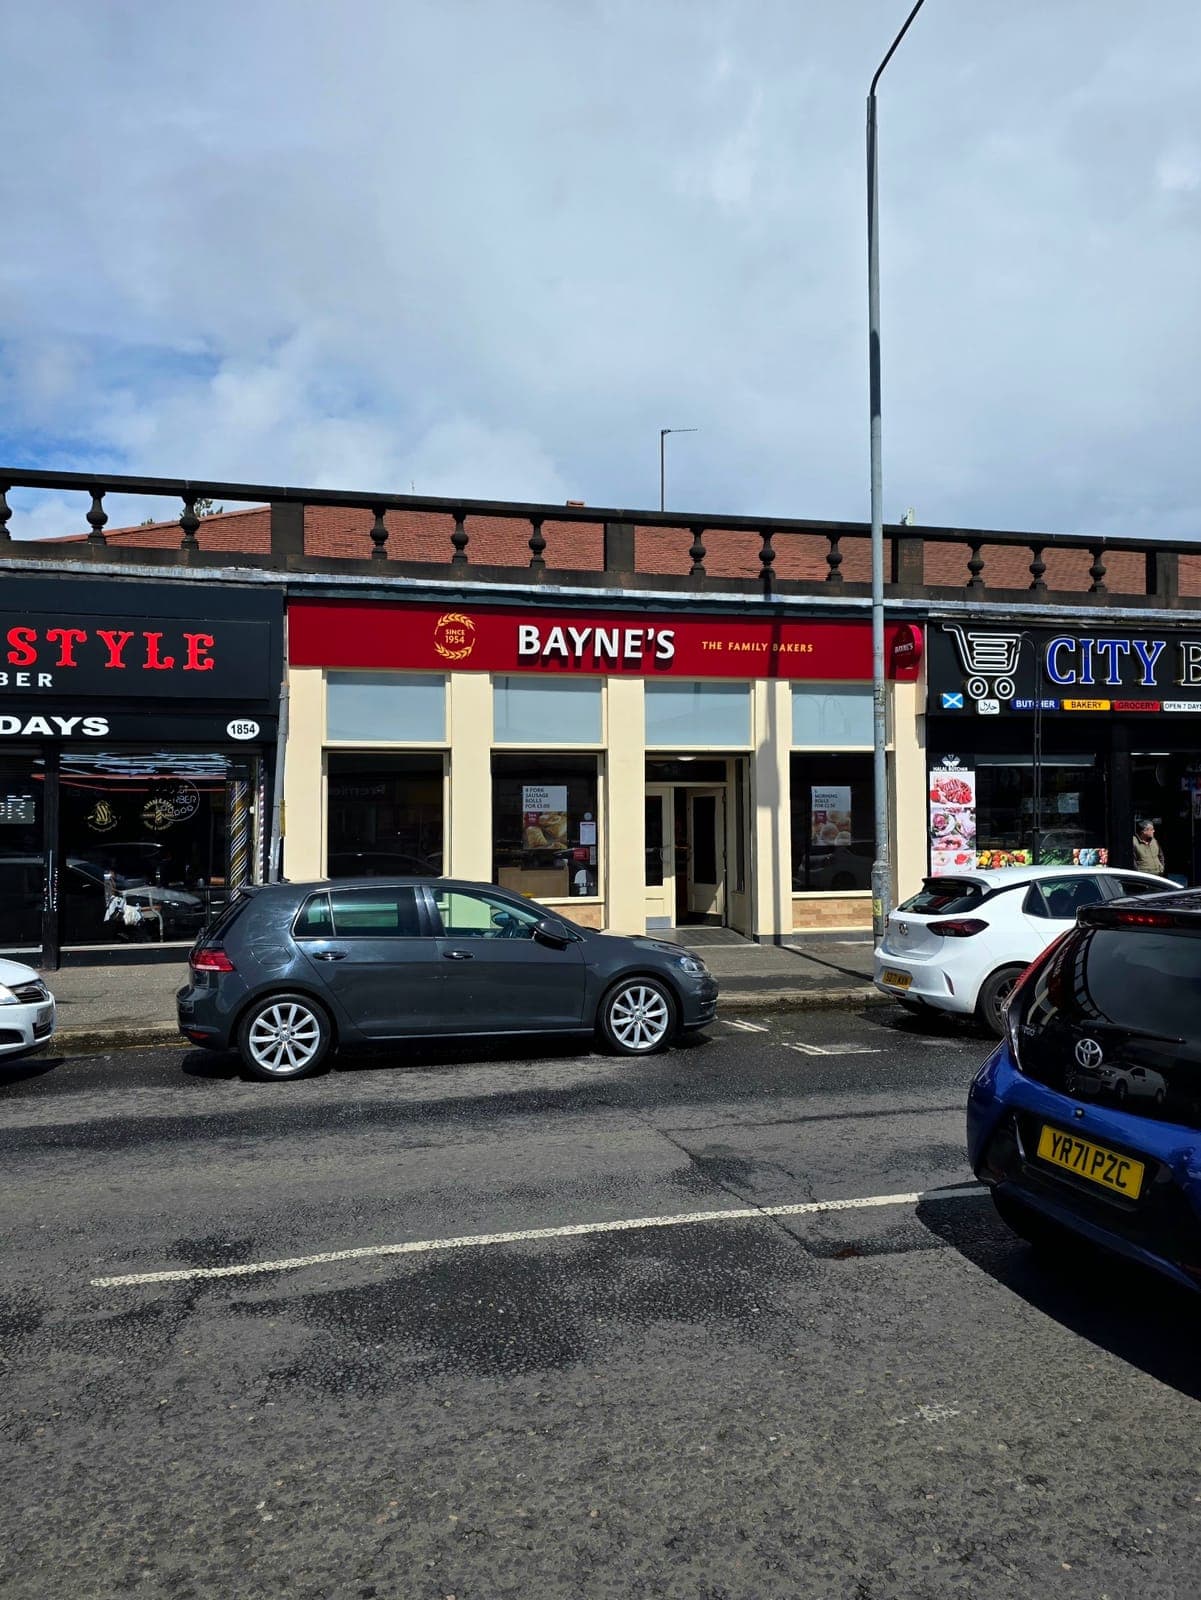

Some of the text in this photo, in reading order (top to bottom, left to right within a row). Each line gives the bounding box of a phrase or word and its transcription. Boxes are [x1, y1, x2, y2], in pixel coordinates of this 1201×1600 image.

[445, 635, 465, 644] 1954
[518, 625, 675, 659] BAYNE'S
[701, 641, 814, 653] THE FAMILY BAKERS
[7, 627, 215, 670] STYLE
[1046, 637, 1166, 686] CITY
[1071, 701, 1102, 709] BAKERY
[1118, 702, 1155, 710] GROCERY
[0, 716, 110, 736] DAYS
[231, 724, 255, 735] 1854
[1052, 1133, 1130, 1188] YR71 PZC
